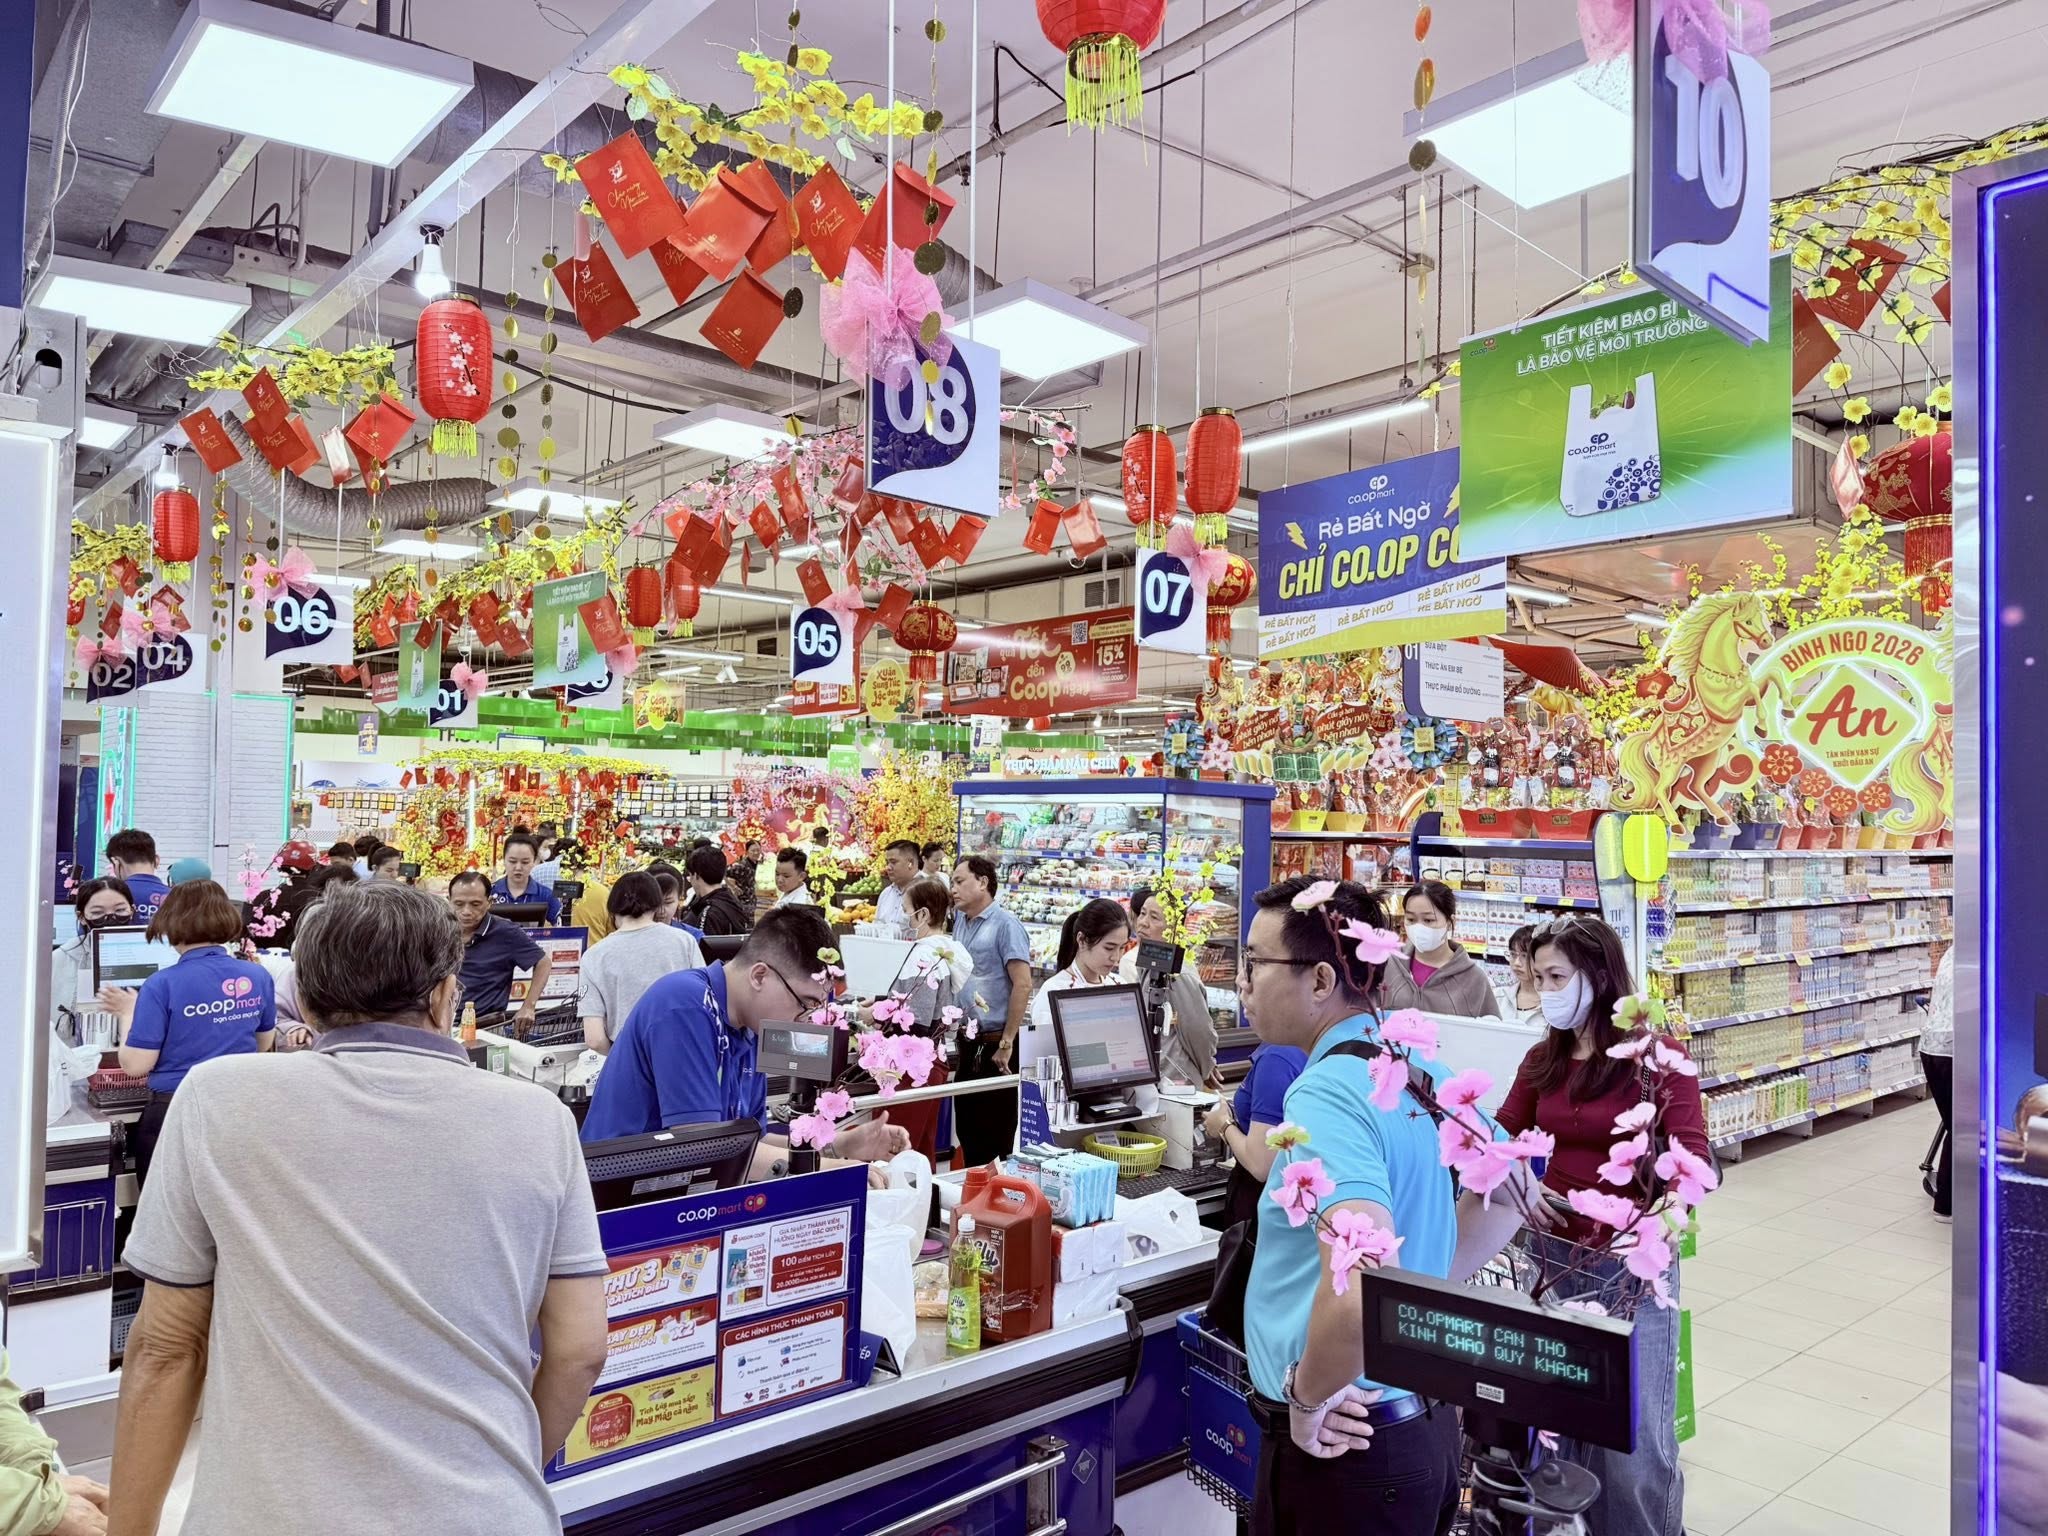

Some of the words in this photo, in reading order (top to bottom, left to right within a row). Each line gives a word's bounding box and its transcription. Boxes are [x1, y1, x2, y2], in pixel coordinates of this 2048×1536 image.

[1665, 55, 1744, 209] 10
[1542, 325, 1576, 348] TIẾT
[1578, 317, 1621, 343] KIỆM
[1621, 306, 1658, 329] BAO
[1659, 298, 1678, 319] BÌ
[1516, 354, 1537, 376] LÀ
[1538, 344, 1573, 369] BẢO
[1573, 338, 1596, 362] VỆ
[1597, 331, 1631, 357] MÔI
[1634, 314, 1708, 347] TRƯỜNG
[884, 356, 969, 445] 08
[1319, 517, 1344, 540] Rẻ
[1347, 508, 1384, 535] Bất
[1388, 500, 1432, 530] Ngờ
[1278, 543, 1328, 600] CHỈ
[1330, 534, 1420, 589] CO.OP
[1145, 569, 1192, 617] 07
[1417, 588, 1431, 602] RẺ
[1433, 582, 1454, 597] BẤT
[1456, 573, 1480, 591] NGỜ
[1456, 595, 1483, 608] NGỜ
[273, 596, 330, 635] 06
[1277, 615, 1295, 627] BẤT
[1351, 605, 1371, 621] BẤT
[1372, 600, 1394, 616] NGỜ
[798, 620, 838, 657] 05
[1013, 625, 1062, 661] Tết
[1278, 630, 1295, 645] BẤT
[1296, 625, 1317, 639] NGỜ
[1404, 643, 1419, 661] 01
[1828, 630, 1868, 655] NGỌ
[1871, 631, 1925, 667] 2026
[142, 643, 187, 672] 04
[1026, 660, 1045, 679] đến
[1096, 643, 1125, 667] 15%
[92, 662, 133, 688] 02
[437, 688, 462, 711] 01
[1806, 684, 1898, 746] An
[603, 1267, 641, 1297] THỨ
[642, 1259, 659, 1283] 3
[781, 1256, 797, 1267] 100
[735, 1331, 750, 1341] CÁC
[751, 1325, 769, 1337] HÌNH
[770, 1319, 790, 1332] THỨC
[791, 1315, 815, 1328] THANH
[816, 1309, 834, 1320] TOÁN
[1398, 1304, 1484, 1338] CO.OPMART
[1493, 1328, 1525, 1348] CAN
[1534, 1337, 1566, 1359] THO
[1398, 1322, 1437, 1344] KINH
[1445, 1334, 1485, 1356] CHAO
[1494, 1345, 1525, 1366] QUY
[1534, 1357, 1589, 1384] KHACH
